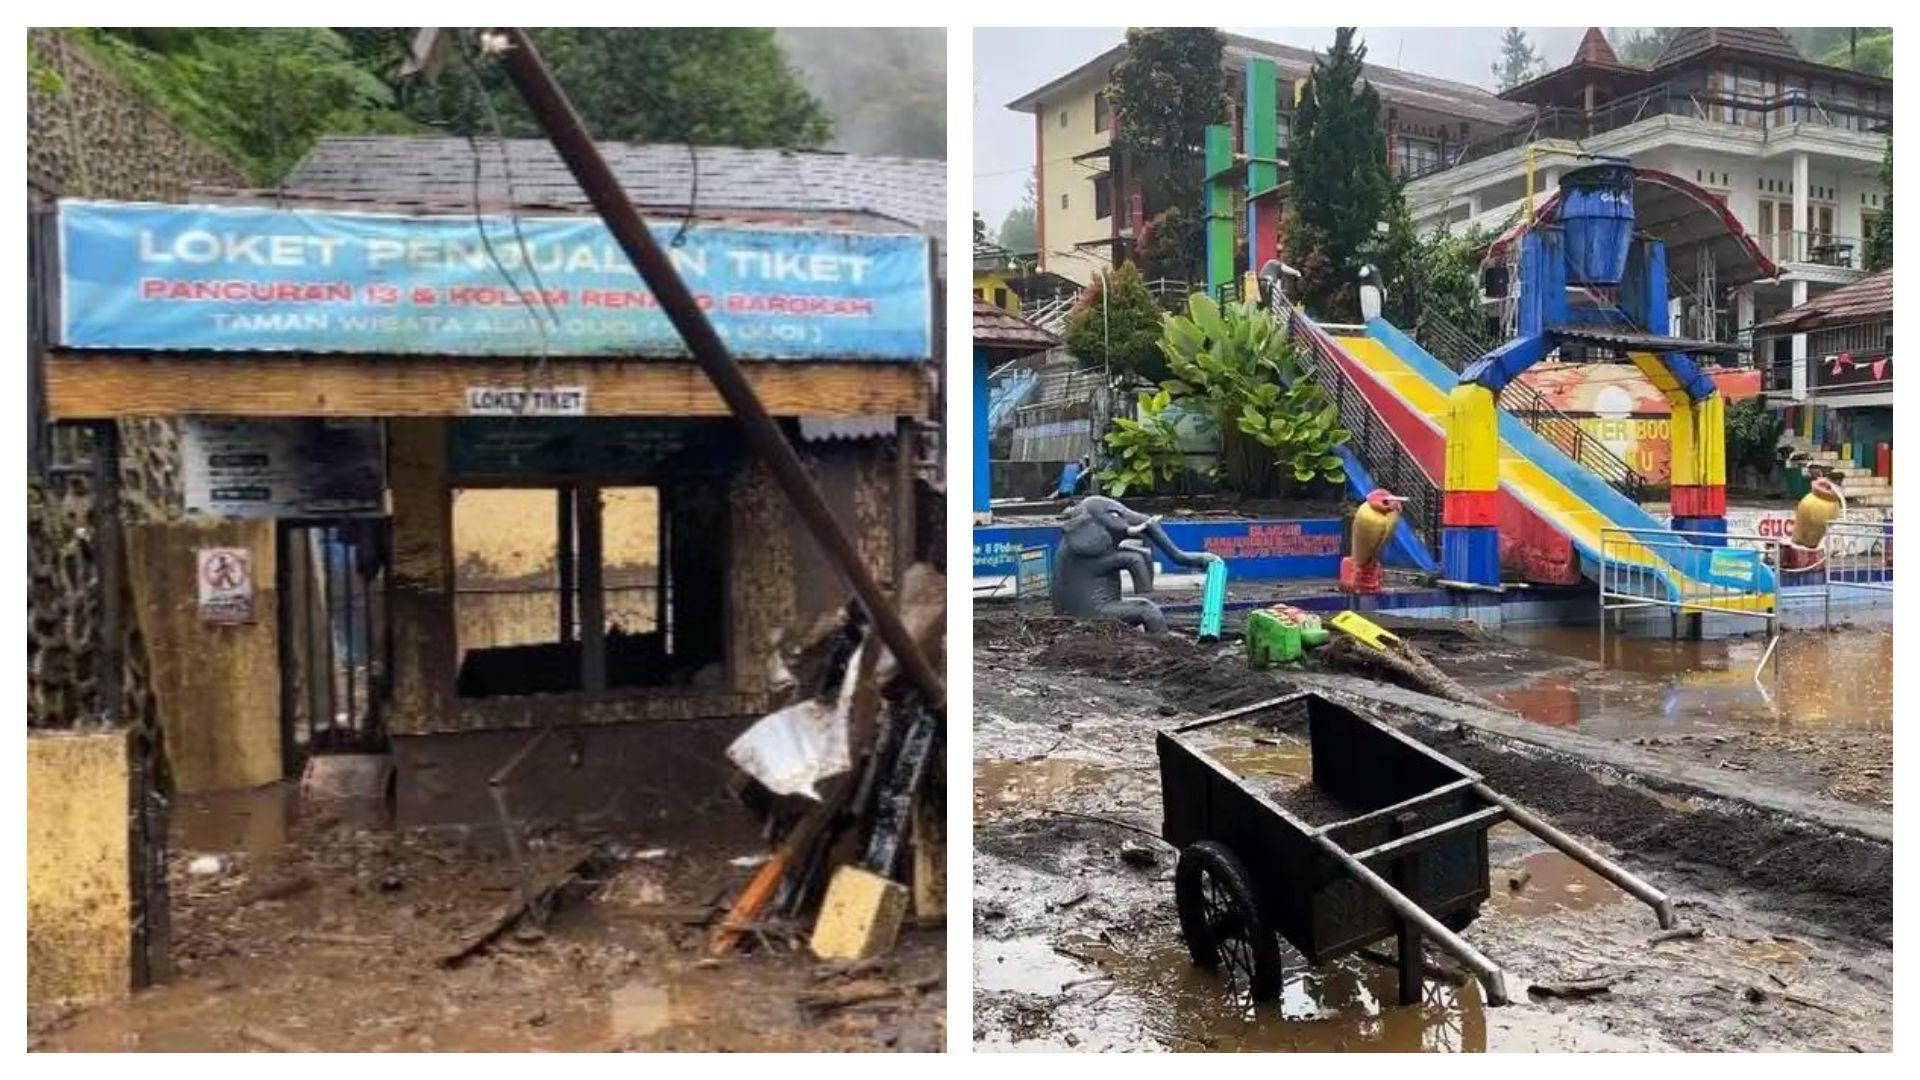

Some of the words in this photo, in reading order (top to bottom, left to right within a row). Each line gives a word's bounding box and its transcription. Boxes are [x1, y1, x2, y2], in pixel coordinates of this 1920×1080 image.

[139, 229, 347, 266] LOKET
[366, 239, 708, 276] PENJUALN
[726, 248, 875, 283] TIKET
[140, 277, 354, 304] PANCURAN
[447, 285, 571, 309] KOLAM
[580, 287, 714, 312] RENG
[727, 291, 875, 318] BAROKAH
[210, 313, 329, 334] TAMAN
[471, 391, 526, 409] LOKET
[533, 391, 582, 409] TIKET
